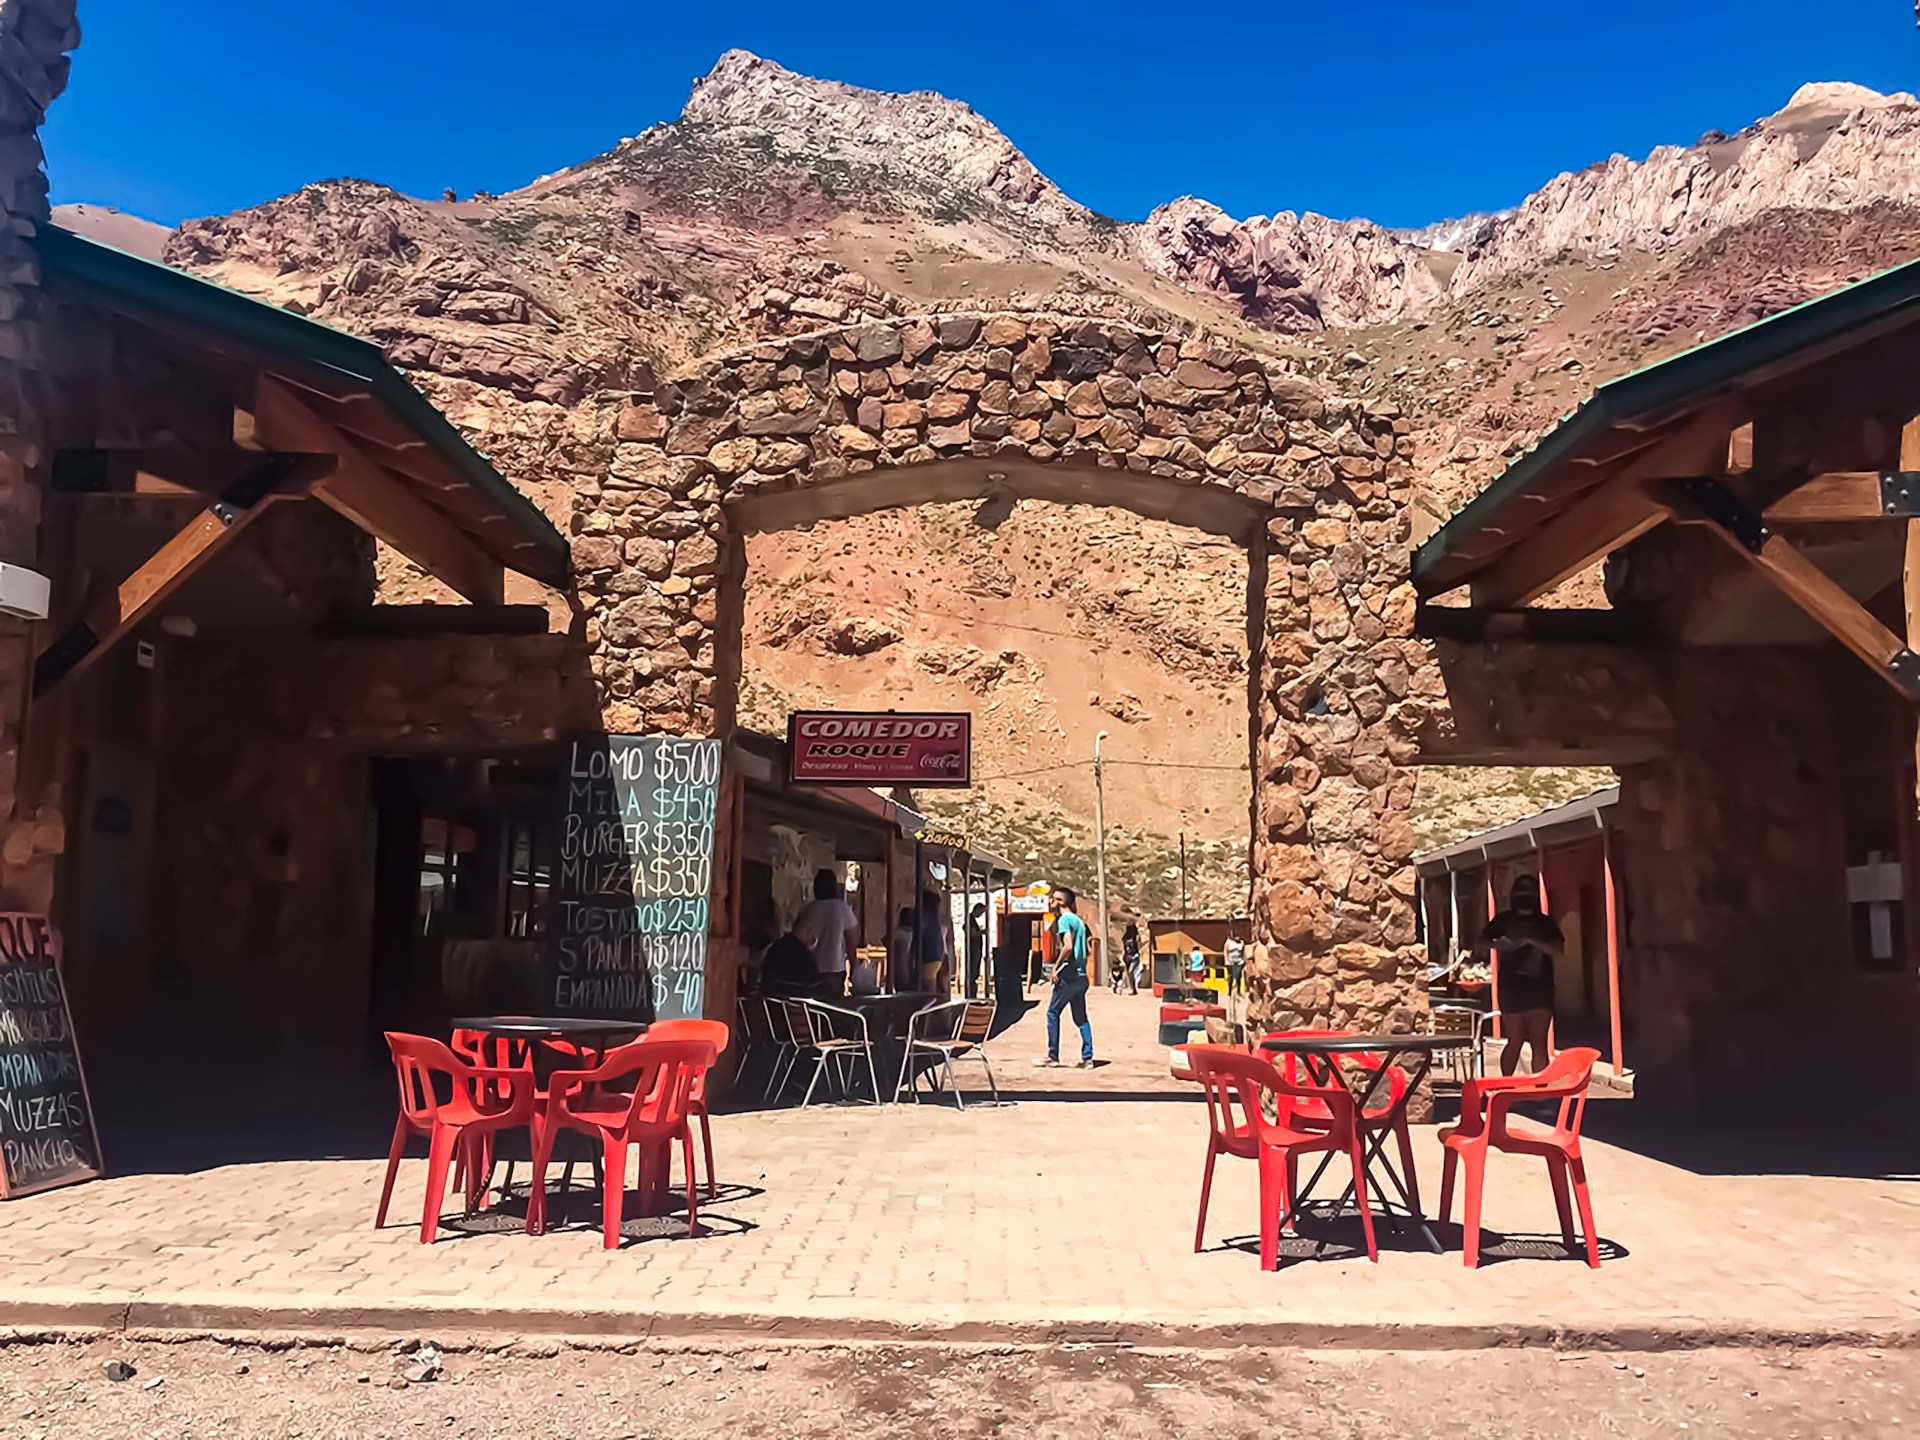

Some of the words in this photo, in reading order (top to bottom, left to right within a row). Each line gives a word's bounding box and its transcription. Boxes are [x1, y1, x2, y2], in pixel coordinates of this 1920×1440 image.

[801, 720, 959, 738] COMEDOR
[571, 741, 643, 780] LOMO
[654, 739, 718, 785] $500
[806, 743, 911, 759] ROQUE
[569, 780, 641, 817] MILA
[652, 783, 715, 824] $450
[561, 814, 648, 860] BURGER
[651, 818, 712, 857] $350
[561, 858, 646, 898] MUZZA
[648, 855, 710, 898] $350
[559, 900, 654, 933] TOSTADO
[653, 897, 707, 933] $250
[653, 931, 704, 972] $120
[555, 974, 648, 1009] EMPANADA
[0, 1091, 84, 1133] MUZZAS
[4, 1133, 91, 1182] PANCHOS
